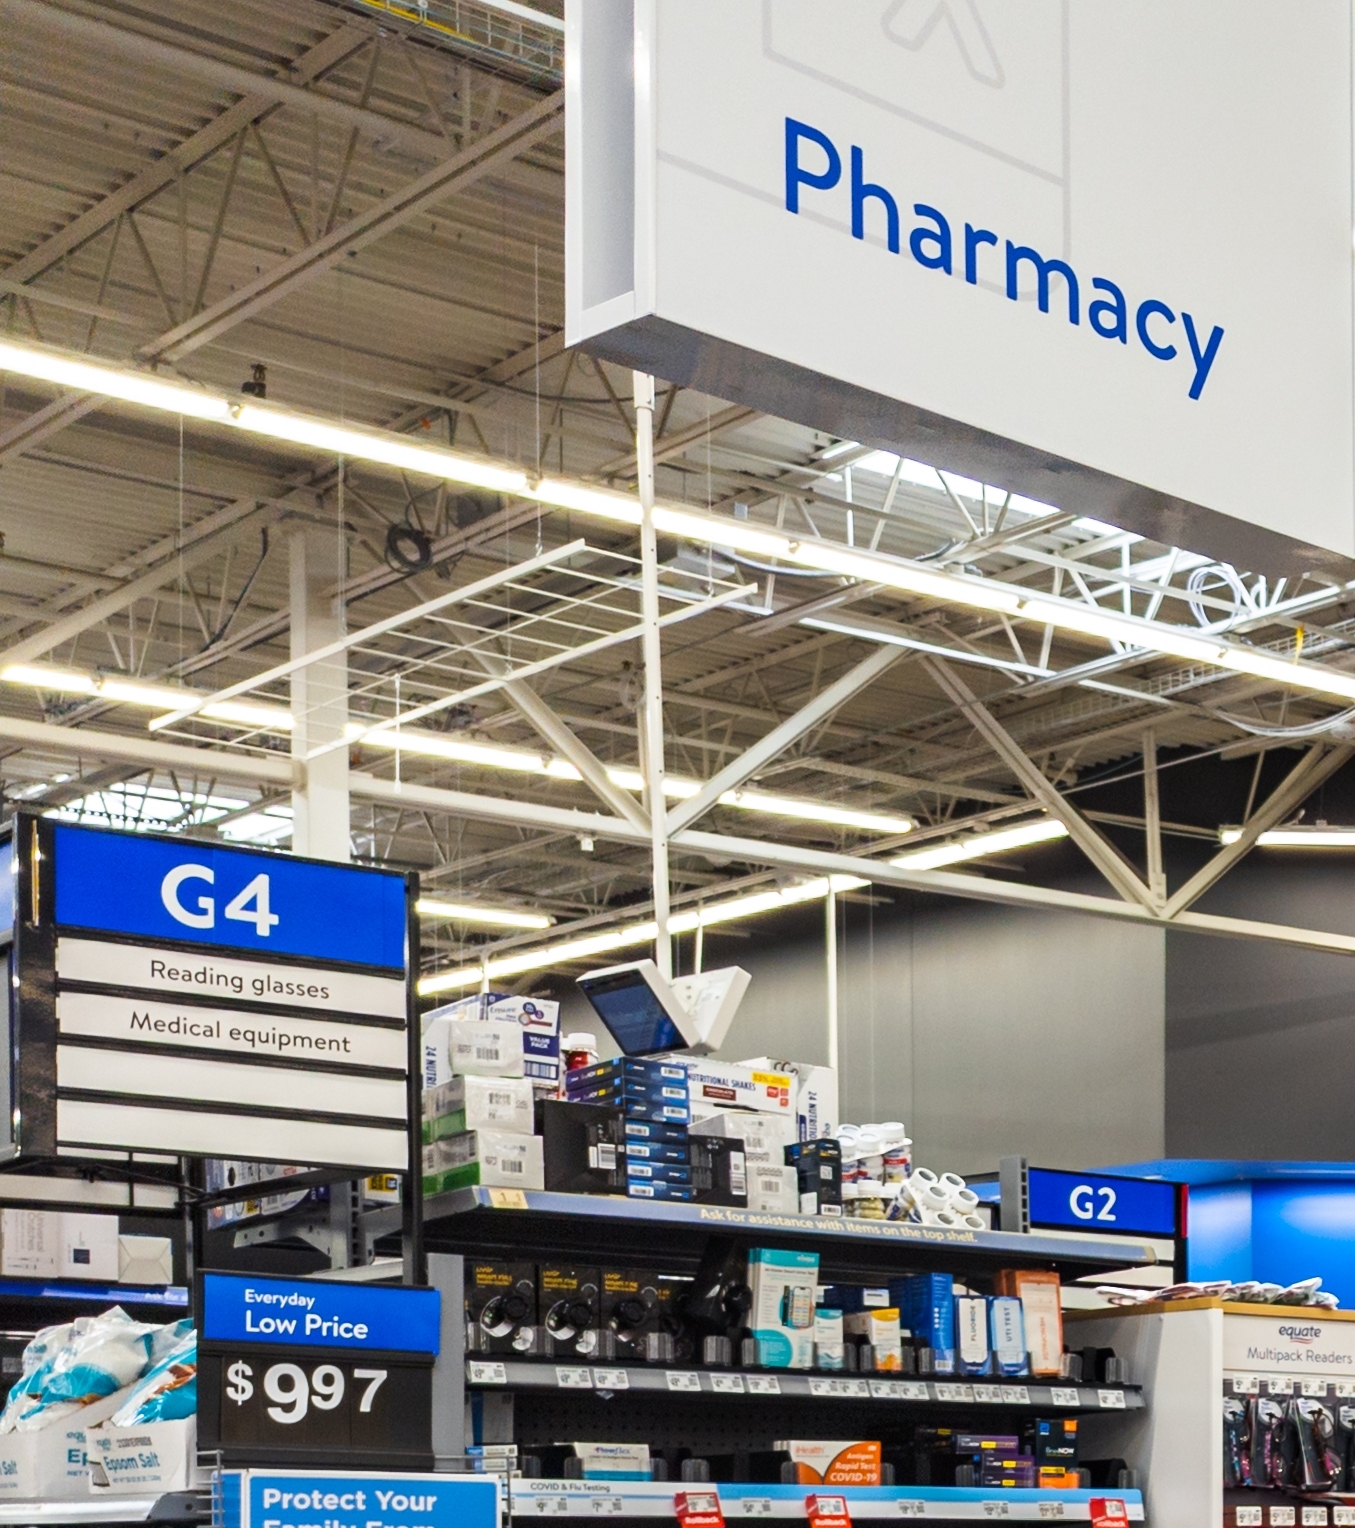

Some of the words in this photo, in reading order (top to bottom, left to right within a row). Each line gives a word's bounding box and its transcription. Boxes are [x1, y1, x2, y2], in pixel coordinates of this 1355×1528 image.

[785, 117, 1225, 400] Pharmacy
[160, 863, 280, 937] G4
[150, 960, 244, 995] Reading
[251, 975, 330, 1001] glasses
[129, 1011, 221, 1039] Medical
[228, 1026, 352, 1053] equipment
[1069, 1184, 1117, 1222] G2
[700, 1208, 725, 1220] Ask
[726, 1211, 746, 1222] for
[748, 1213, 814, 1228] assistance
[815, 1219, 845, 1231] with
[845, 1222, 881, 1235] items
[882, 1226, 900, 1236] on
[901, 1227, 922, 1238] the
[923, 1229, 944, 1241] top
[946, 1229, 978, 1242] shelf.
[244, 1289, 315, 1309] Everyday
[245, 1310, 297, 1334] Low
[304, 1313, 369, 1340] Price
[970, 1304, 978, 1342] FLUORIDE
[1279, 1325, 1322, 1340] equate
[1247, 1347, 1302, 1363] Multipack
[1305, 1350, 1353, 1364] Readers
[103, 1455, 139, 1472] Epsom
[138, 1451, 161, 1468] Salt
[262, 1488, 367, 1510] Protect
[375, 1490, 437, 1511] Your
[530, 1482, 560, 1492] COVID
[561, 1483, 567, 1492] &
[569, 1482, 583, 1492] Flu
[584, 1483, 611, 1494] Testing
[684, 1515, 720, 1525] Rollback
